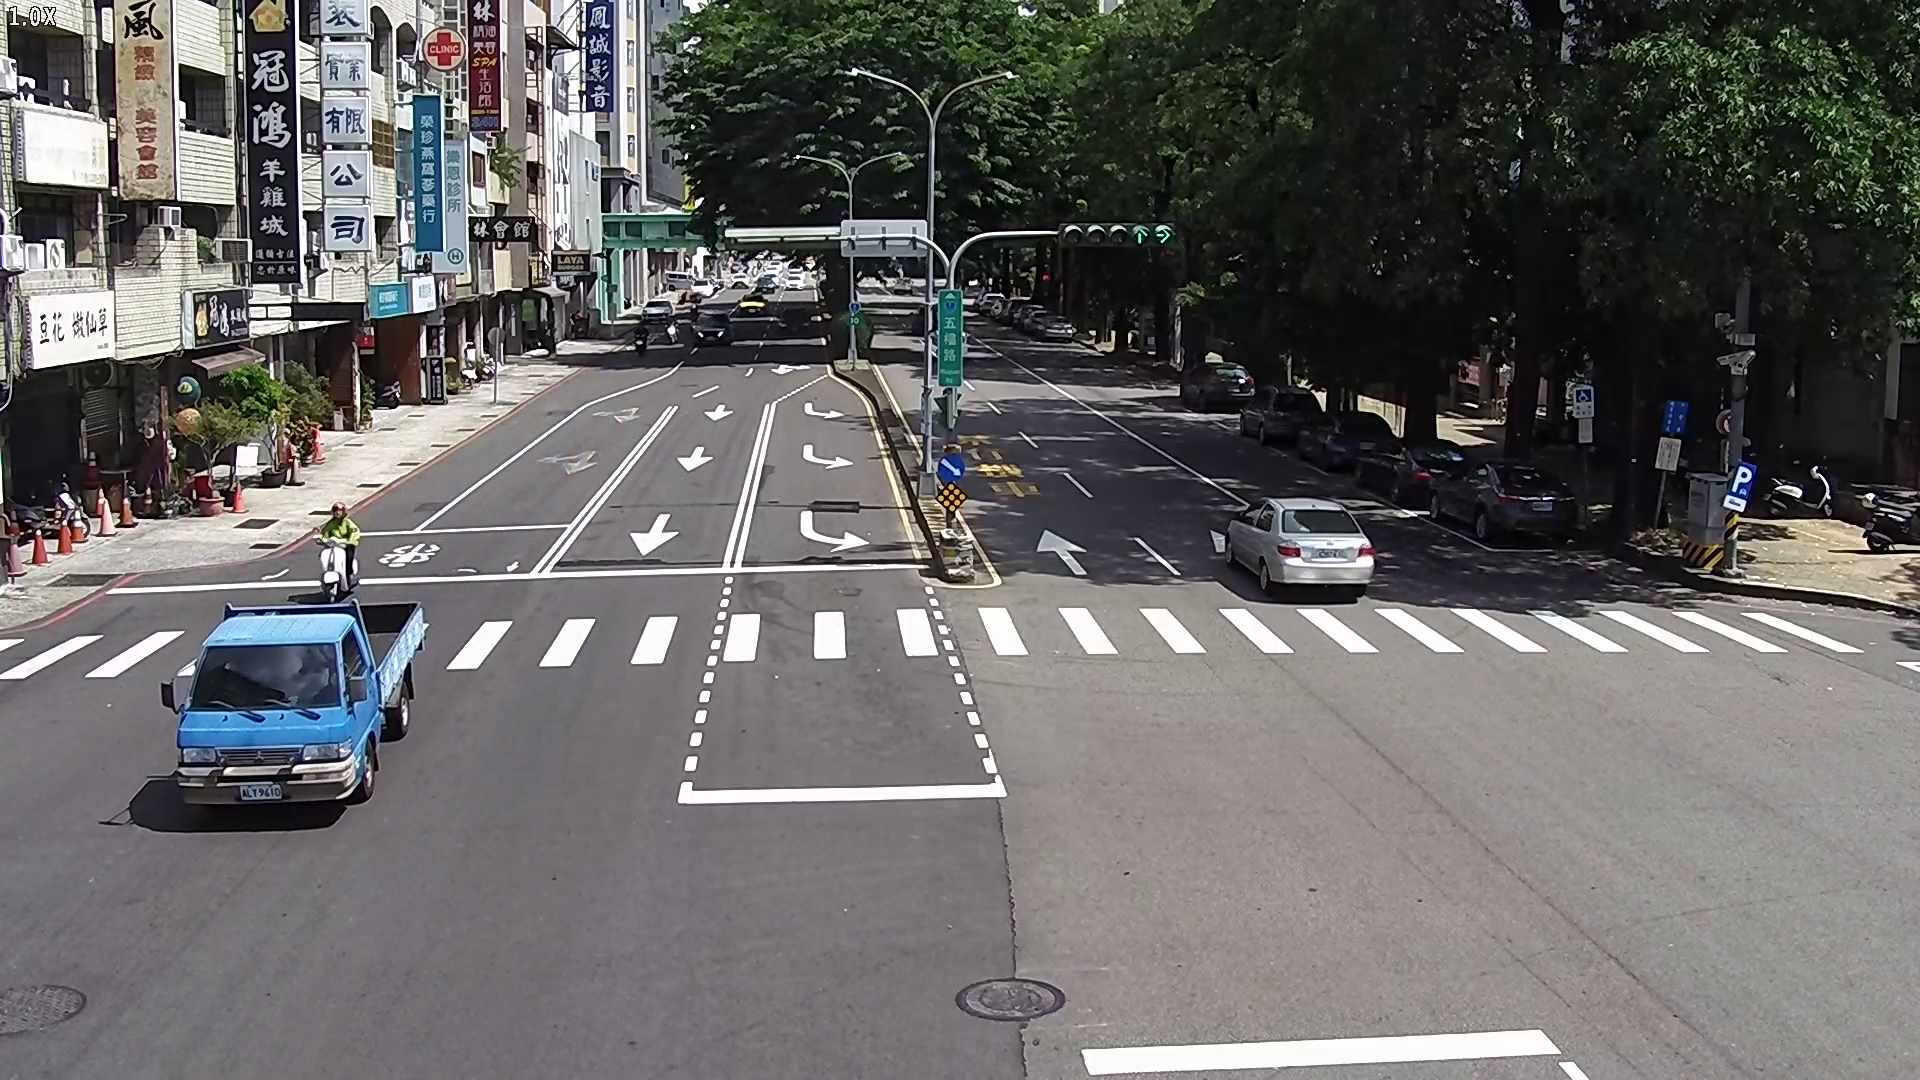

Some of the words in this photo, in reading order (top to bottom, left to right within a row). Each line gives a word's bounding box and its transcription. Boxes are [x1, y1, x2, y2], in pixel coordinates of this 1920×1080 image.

[429, 45, 459, 54] CLINIC
[471, 57, 497, 67] SPA
[943, 317, 957, 361] 五福路
[1731, 466, 1753, 493] P
